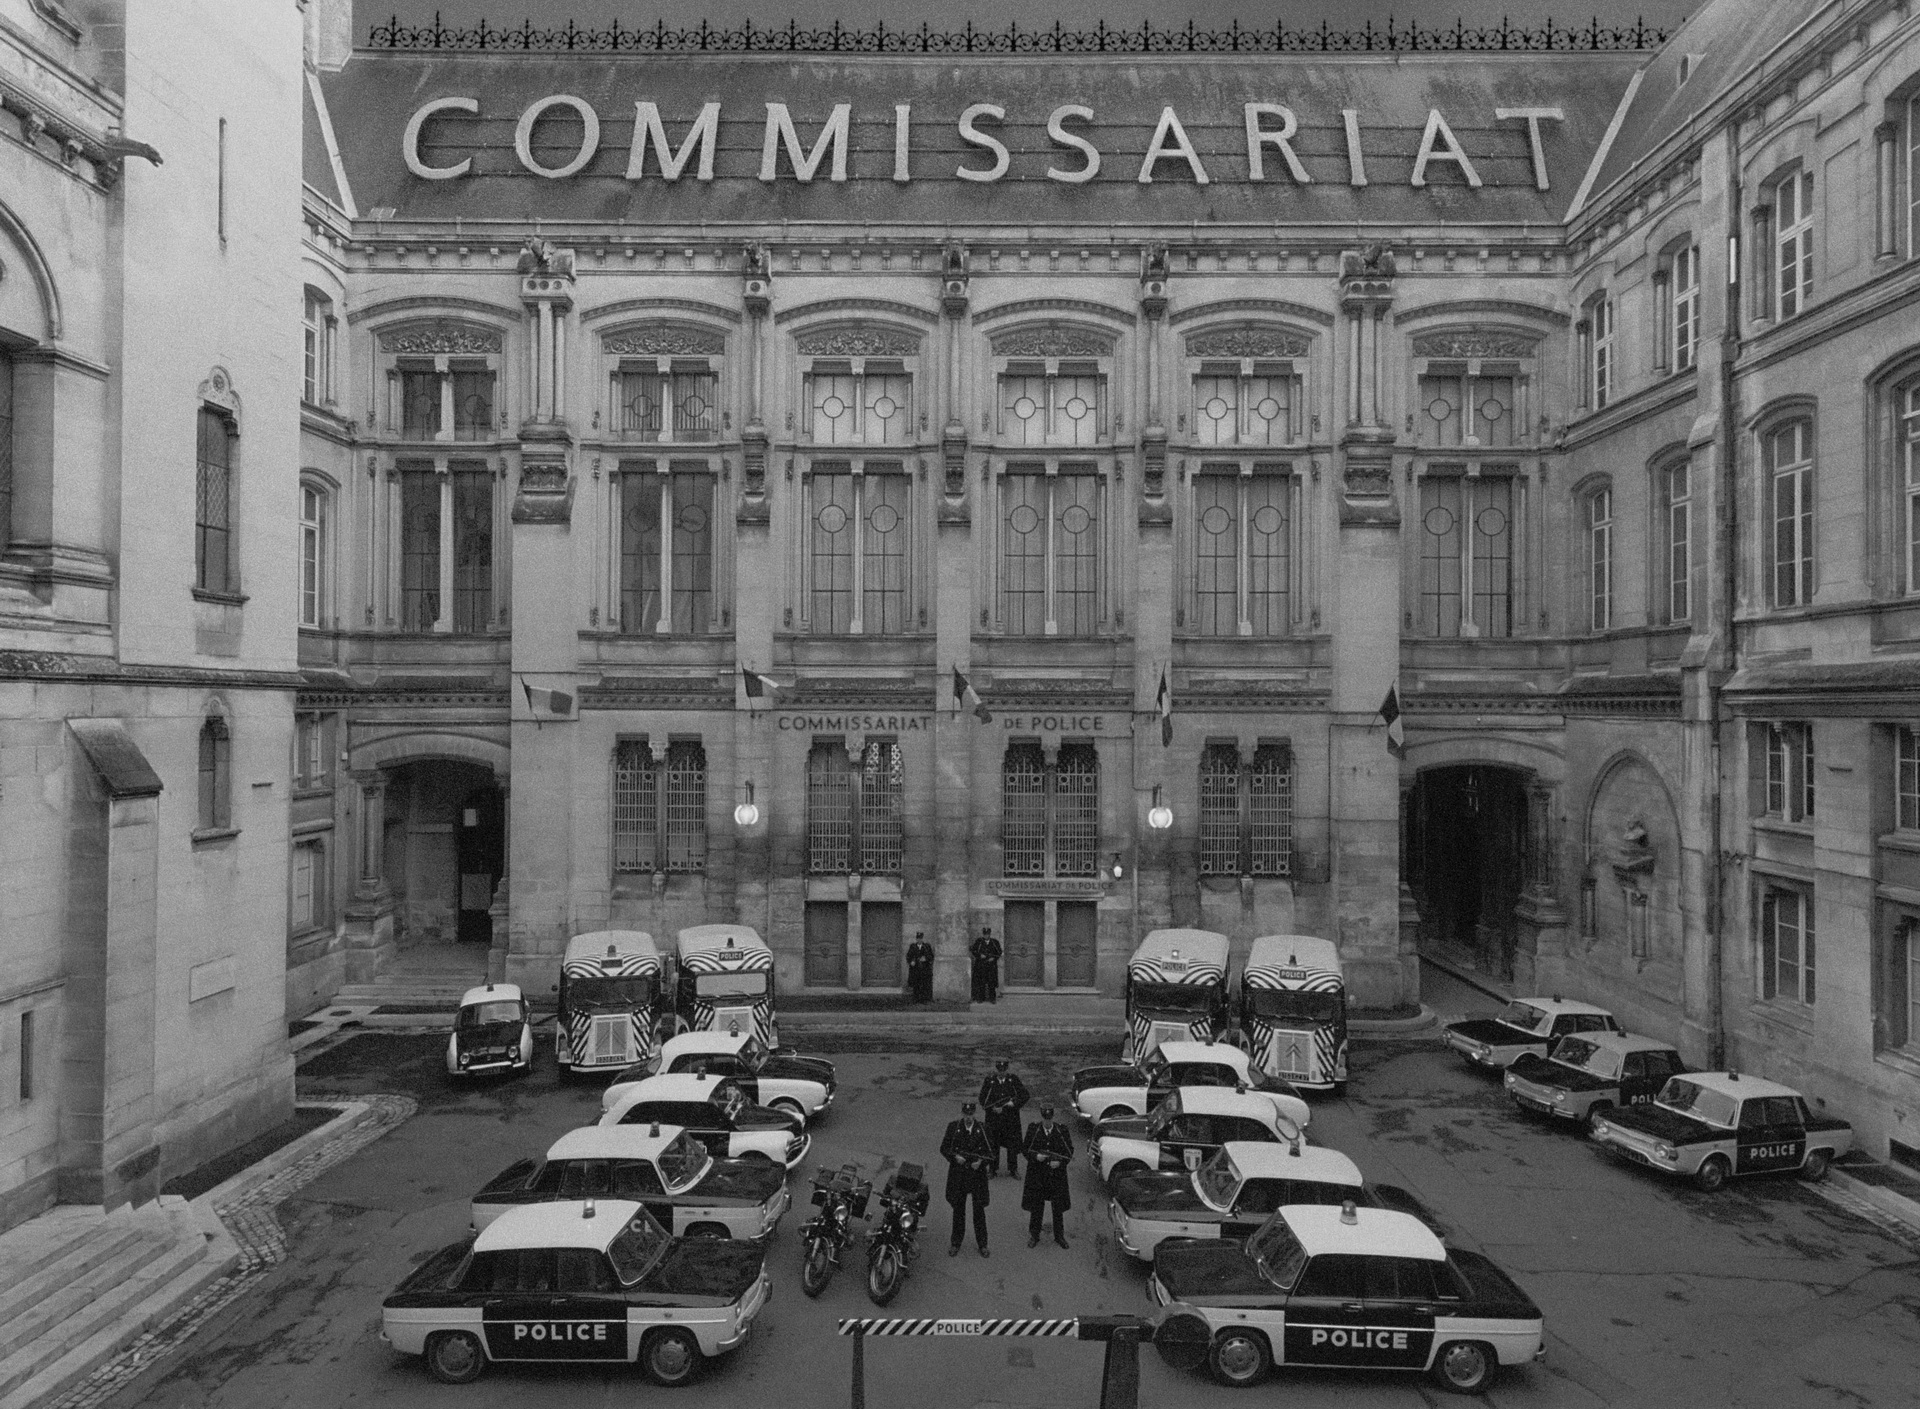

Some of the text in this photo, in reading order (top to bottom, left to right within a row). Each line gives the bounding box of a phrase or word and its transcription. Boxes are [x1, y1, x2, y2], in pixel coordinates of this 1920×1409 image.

[402, 94, 1565, 190] COMMISSARIAT
[778, 716, 1104, 731] COMMISSARIAT DE POLICE
[988, 881, 1062, 890] COMMISSARIAT
[1078, 882, 1114, 890] POLICE
[720, 951, 743, 960] POLICE
[1163, 961, 1187, 972] POLICE
[1280, 970, 1305, 979] POLICE
[1749, 1143, 1797, 1159] POLICE
[513, 1323, 607, 1341] POLICE
[936, 1323, 981, 1334] POLICE
[1311, 1329, 1408, 1350] POLICE
